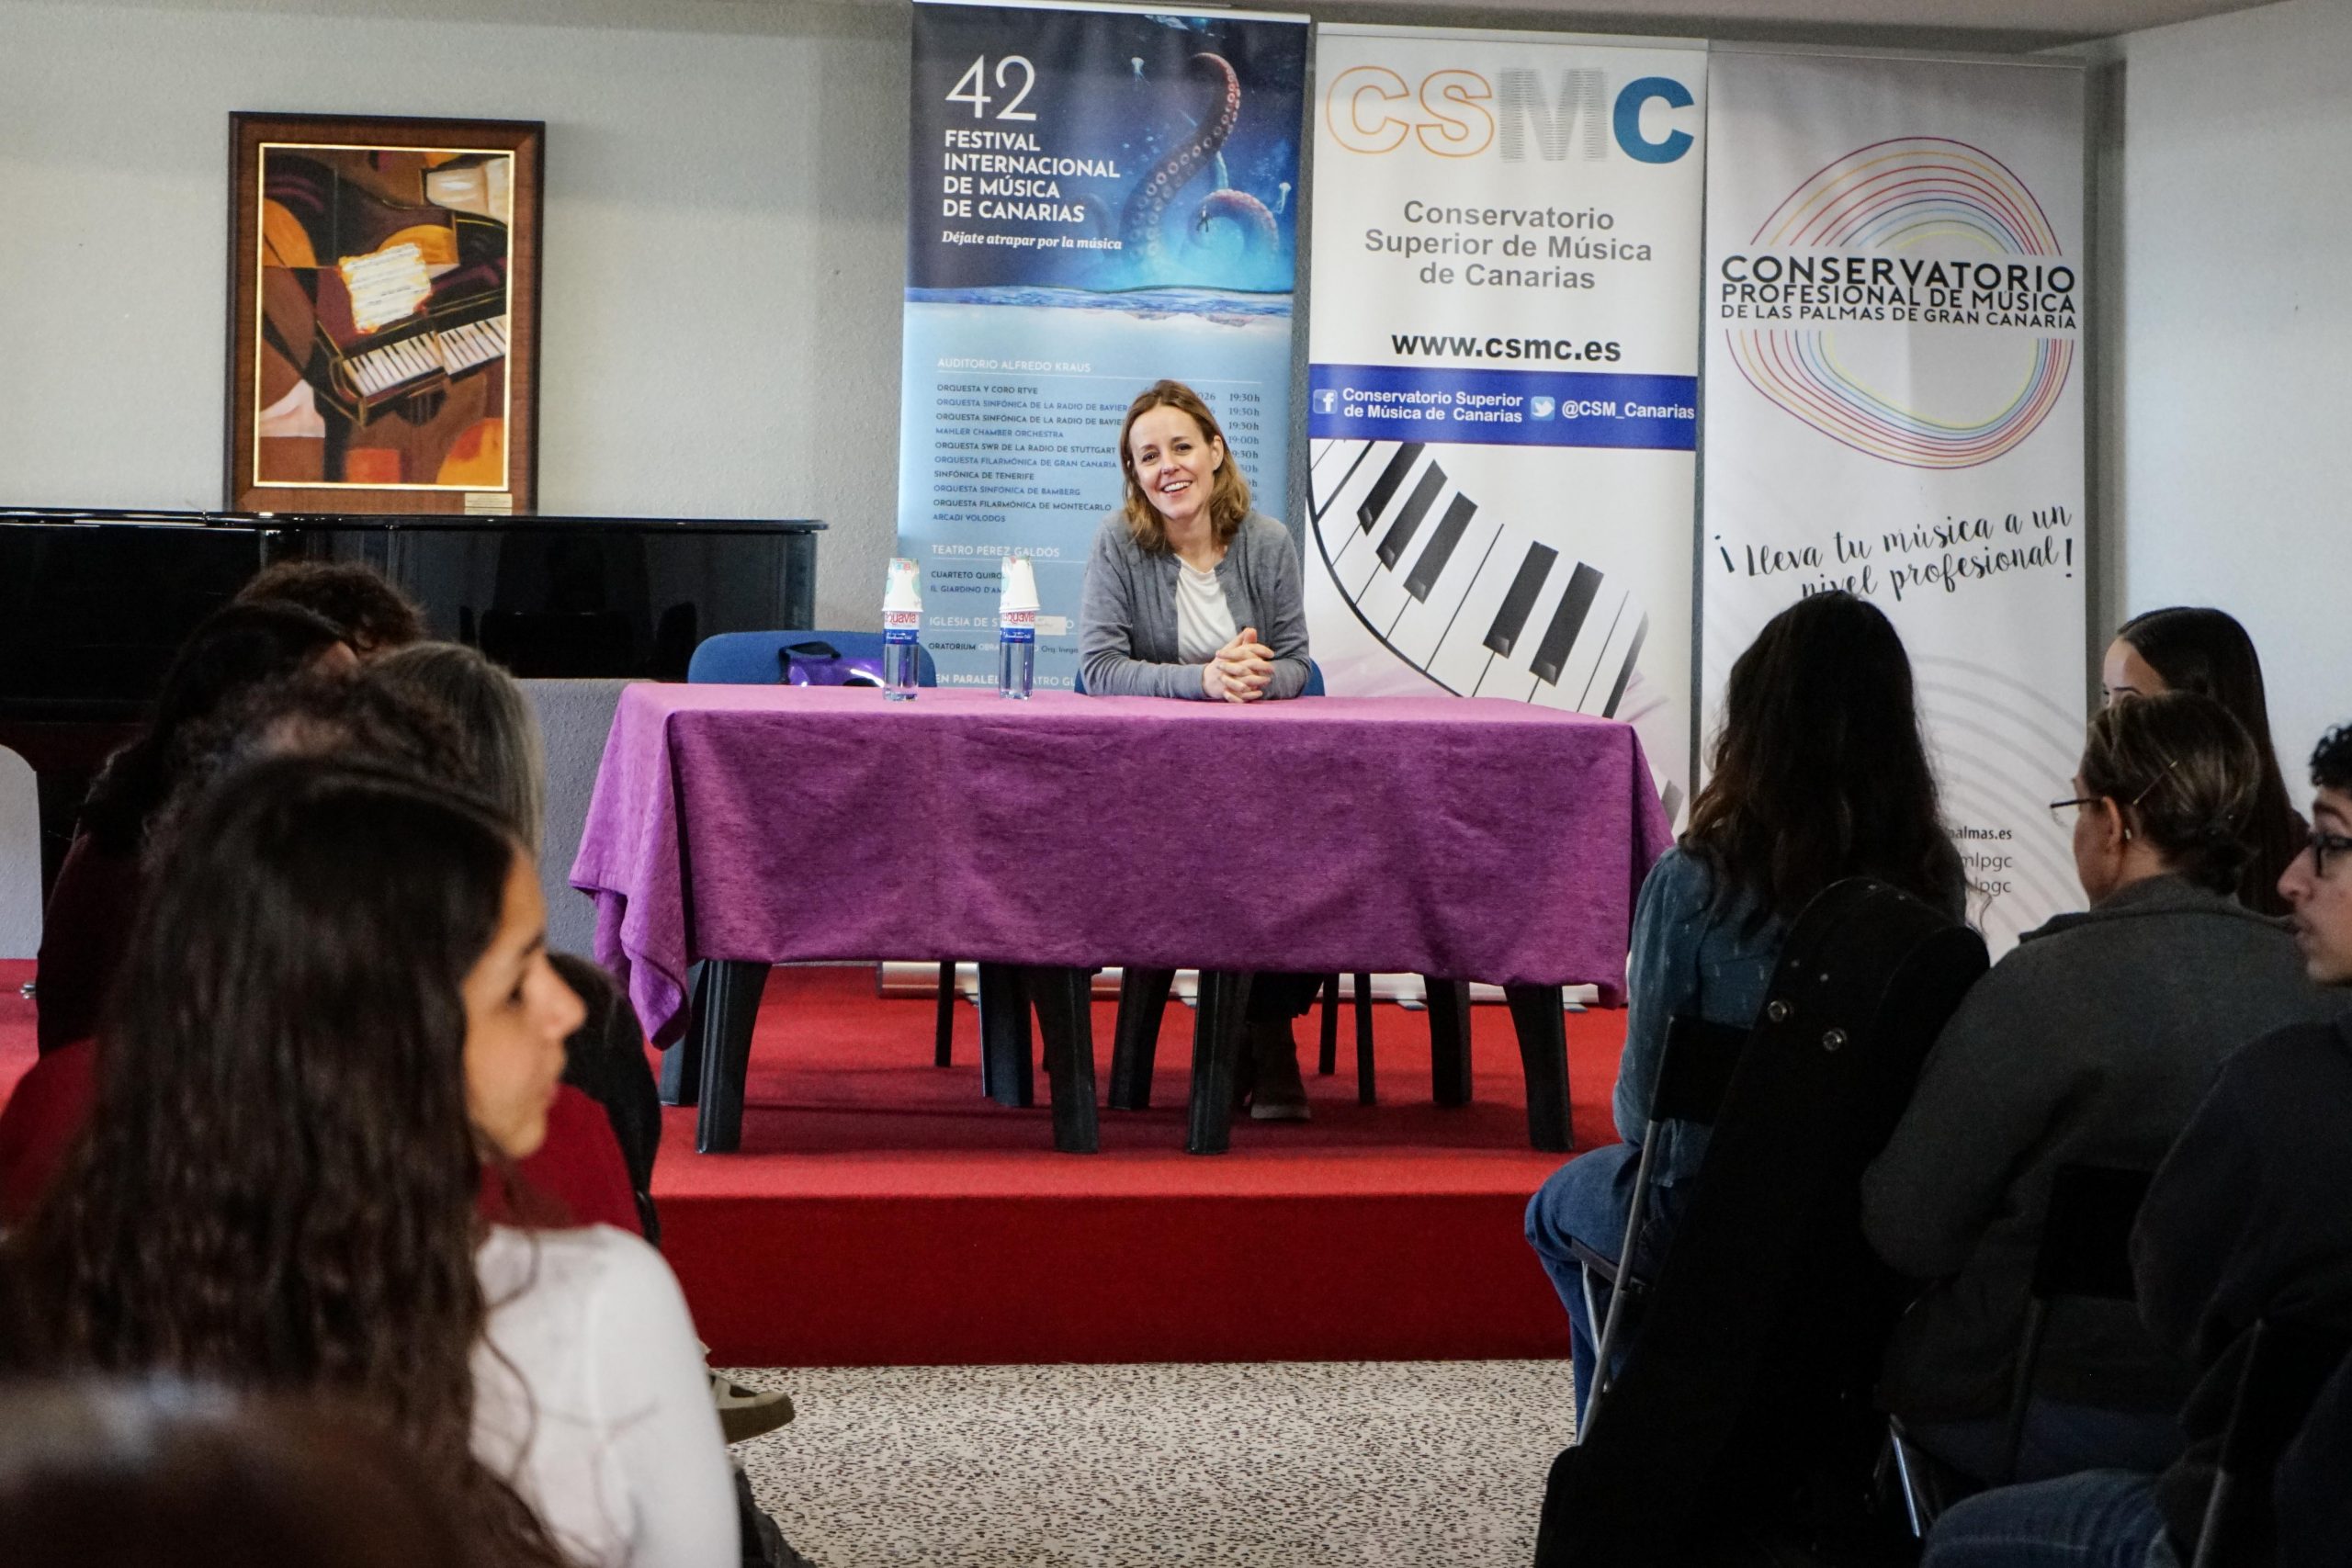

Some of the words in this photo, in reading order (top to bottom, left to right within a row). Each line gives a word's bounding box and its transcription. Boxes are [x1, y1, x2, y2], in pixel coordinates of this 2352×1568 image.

[944, 54, 1036, 121] 42
[1326, 66, 1695, 164] CSMC
[944, 130, 1040, 152] FESTIVAL
[944, 153, 1120, 178] INTERNACIONAL
[944, 175, 972, 196] DE
[979, 175, 1060, 199] MÚSICA
[943, 198, 971, 218] DE
[978, 200, 1085, 223] CANARIAS
[1403, 199, 1614, 231] Conservatorio
[942, 230, 984, 247] Déjate
[986, 232, 1035, 248] atrapar
[1037, 236, 1059, 250] por
[1061, 235, 1074, 248] la
[1076, 236, 1123, 251] música
[1365, 229, 1493, 258] Superior
[1502, 234, 1537, 257] de
[1548, 235, 1652, 261] Música
[1419, 262, 1454, 284] de
[1465, 263, 1596, 289] Canarias
[1721, 254, 2075, 294] CONSERVATORIO
[1722, 283, 1921, 307] PROFESIONAL
[1930, 288, 1962, 309] DE
[1972, 289, 2076, 314] MÚSICA
[1722, 305, 1748, 319] DE
[1756, 305, 1792, 320] LAS
[1800, 306, 1885, 321] PALMAS
[1893, 307, 1918, 321] DE
[1925, 309, 1979, 325] GRAN
[1986, 312, 2076, 330] CANARIA
[1391, 333, 1622, 362] www.csmc.es
[937, 358, 998, 369] AUDITORIO
[1001, 360, 1053, 372] ALFREDO
[1056, 362, 1091, 373] KRAUS
[937, 384, 981, 393] ORQUESTA
[991, 386, 1014, 394] CORO
[1017, 387, 1038, 395] RTVE
[1197, 392, 1216, 400] 026
[1342, 388, 1452, 405] Conservatorio
[1455, 391, 1523, 409] Superior
[936, 398, 980, 407] ORQUESTA
[983, 399, 1027, 409] SINFÓNICA
[1044, 401, 1054, 410] LA
[1057, 402, 1083, 411] RADIO
[1099, 403, 1128, 412] BAVIER
[1344, 404, 1363, 418] de
[1367, 404, 1422, 420] Música
[1425, 406, 1445, 420] de
[1453, 407, 1522, 423] Canarias
[1561, 400, 1695, 420] @CSM_Canarias
[936, 412, 980, 422] ORQUESTA
[982, 413, 1027, 423] SINFÓNICA
[1029, 415, 1040, 423] DE
[935, 427, 971, 435] MAHLER
[973, 428, 1012, 436] CHAMBER
[1014, 429, 1064, 438] ORCHESTRA
[935, 441, 979, 450] ORQUESTA
[1070, 446, 1115, 454] STUTTGART
[934, 456, 978, 465] ORQUESTA
[980, 457, 1037, 467] FILARMÓNICA
[1054, 459, 1078, 468] GRAN
[934, 469, 978, 479] SINFÓNICA
[995, 472, 1035, 480] TENERIFE
[933, 484, 978, 493] ORQUESTA
[979, 485, 1024, 494] SINFÓNICA
[1027, 487, 1038, 495] DE
[1041, 487, 1080, 496] BAMBERG
[933, 499, 977, 508] ORQUESTA
[979, 500, 1036, 509] FILARMÓNICA
[1053, 502, 1112, 512] MONTECARLO
[933, 513, 963, 522] ARCADI
[966, 514, 1005, 523] VOLODOS
[1834, 530, 1872, 564] tu
[1883, 515, 1994, 553] música
[2005, 511, 2023, 535] a
[2031, 504, 2072, 529] un
[932, 545, 973, 556] TEATRO
[977, 545, 1010, 557] PÉREZ
[931, 571, 973, 580] CUARTETO
[1890, 535, 2073, 601] profesional!
[940, 585, 981, 593] GIARDINO
[929, 617, 970, 626] IGLESIA
[974, 617, 988, 626] DE
[928, 642, 976, 650] ORATORIUM
[953, 674, 999, 684] PARALEL
